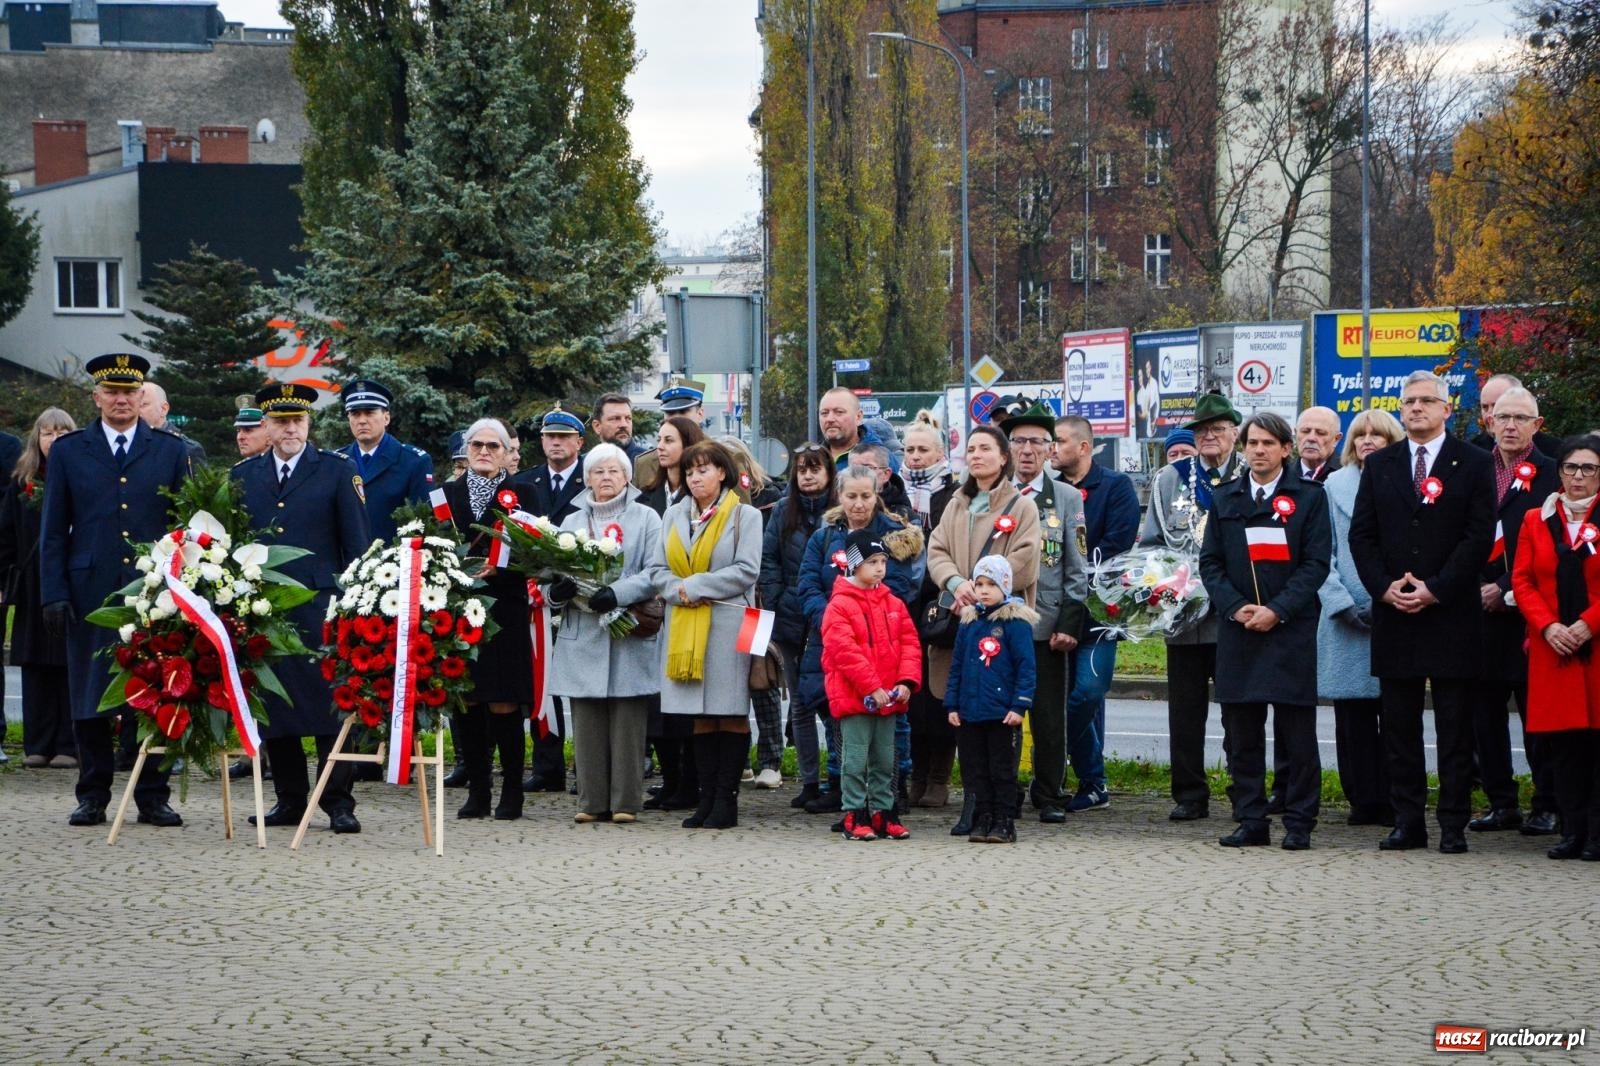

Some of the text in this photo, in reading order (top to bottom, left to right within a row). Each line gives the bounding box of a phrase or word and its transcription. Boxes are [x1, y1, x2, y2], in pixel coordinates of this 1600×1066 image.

[1343, 324, 1455, 345] RT EURO AGD
[1243, 367, 1263, 384] 4 t
[1337, 400, 1351, 412] w
[882, 408, 907, 419] gdzie
